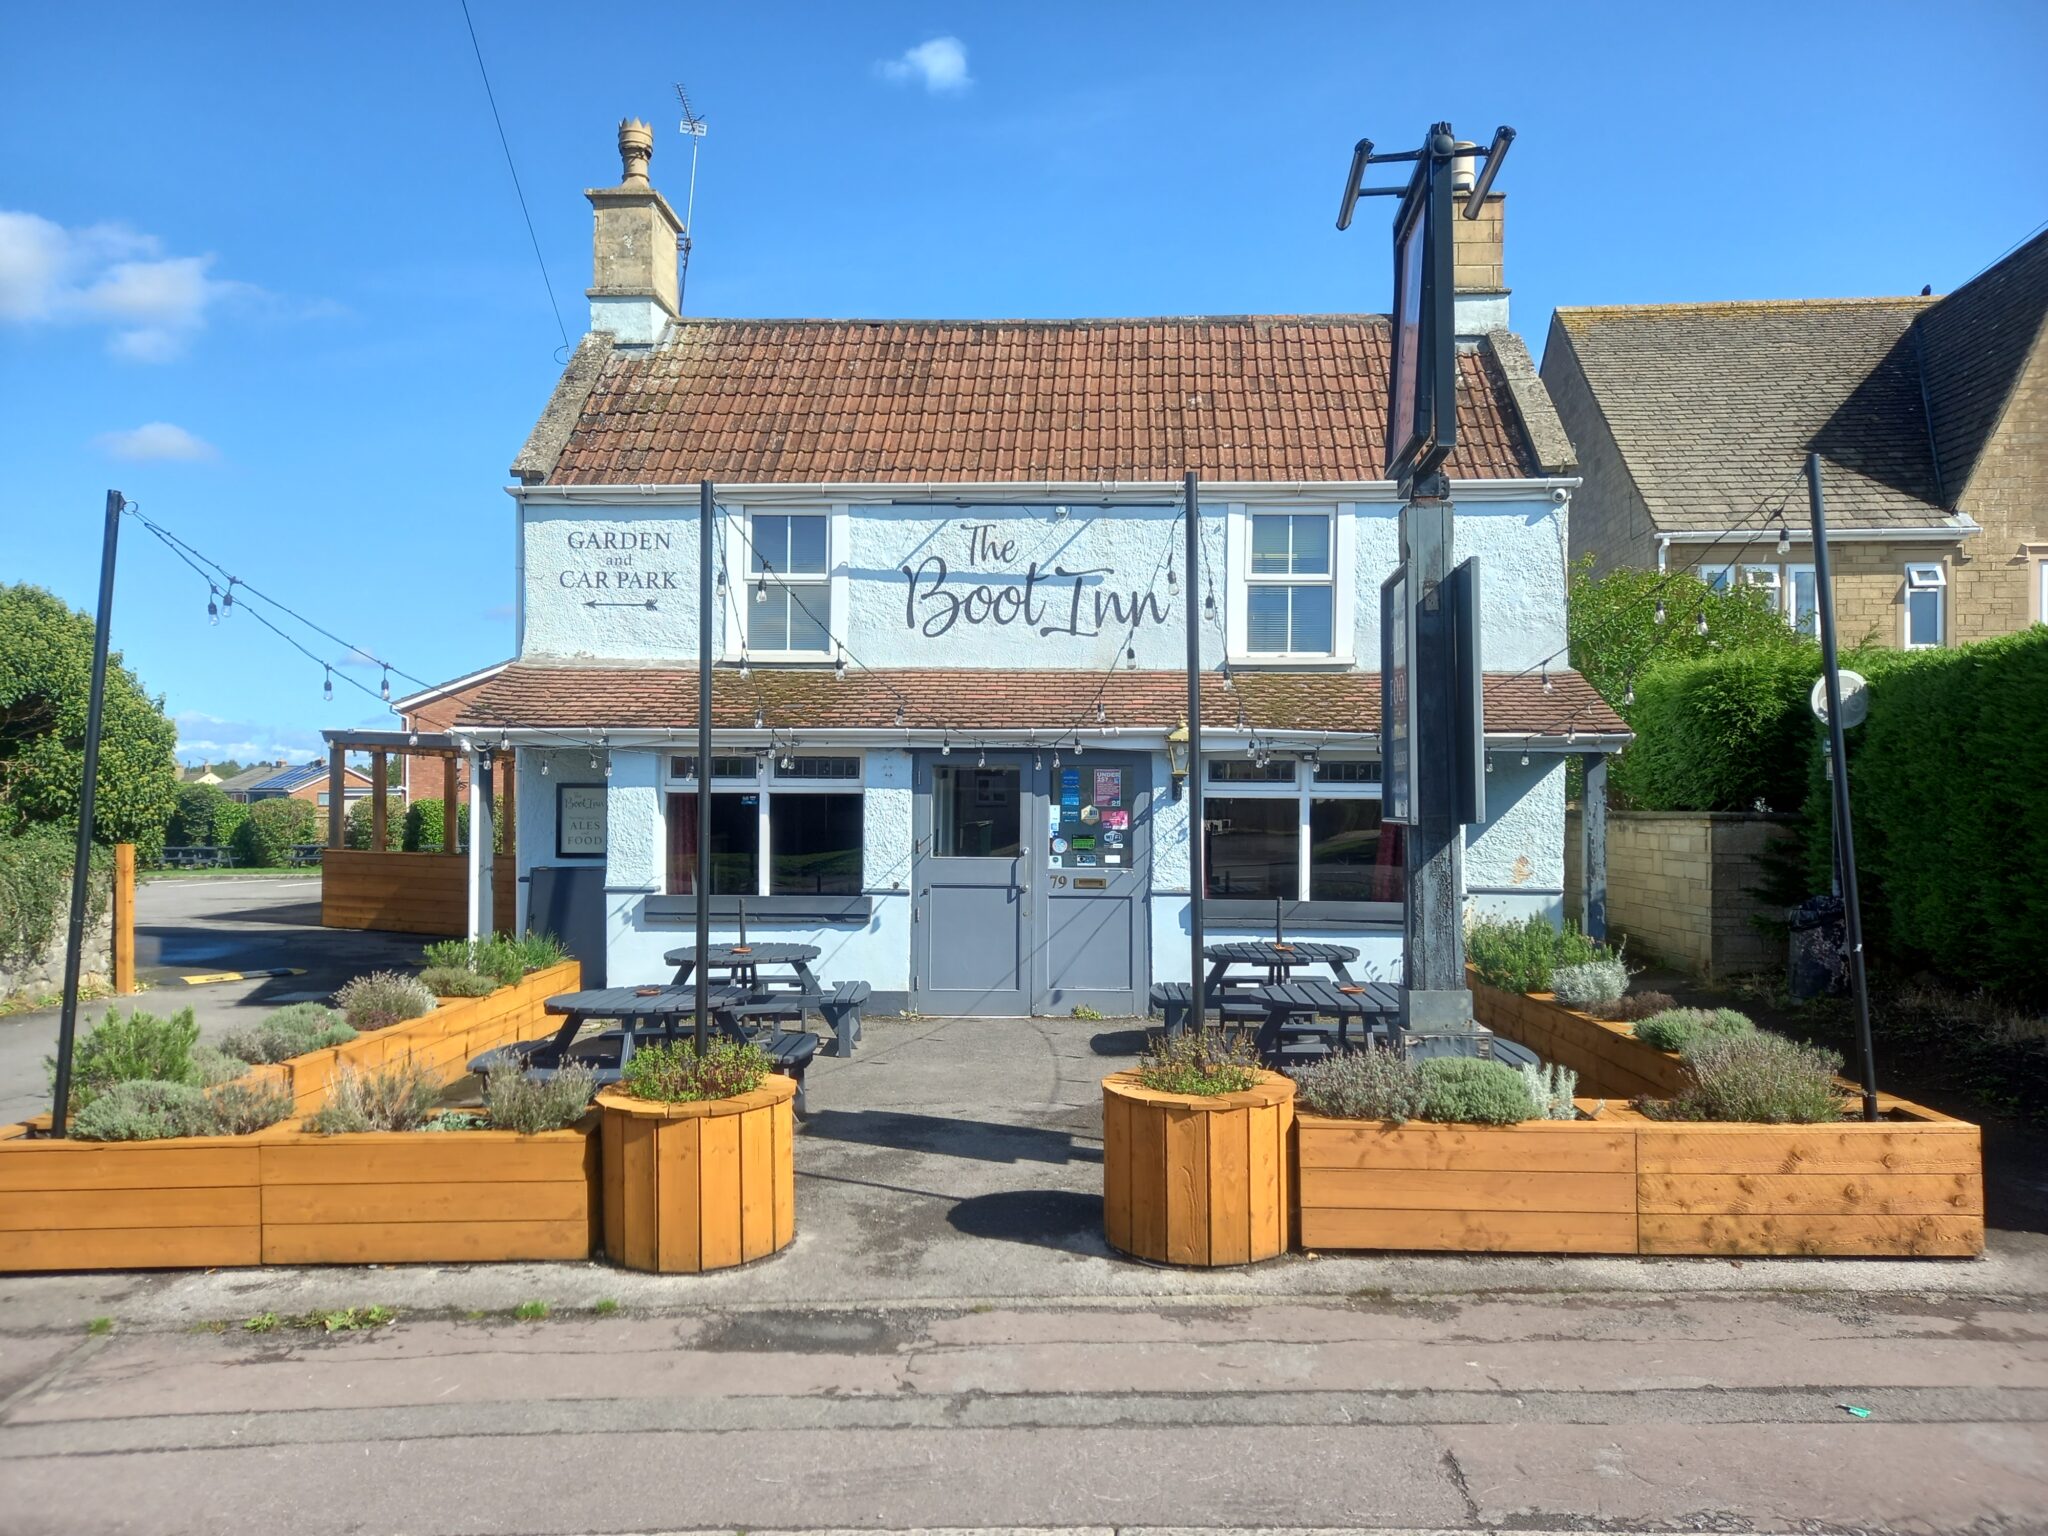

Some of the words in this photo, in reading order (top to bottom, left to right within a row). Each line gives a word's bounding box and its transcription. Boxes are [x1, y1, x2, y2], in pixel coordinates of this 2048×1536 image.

[567, 531, 672, 550] GARDEN
[960, 523, 1019, 566] The
[605, 554, 632, 566] and
[559, 570, 610, 589] CAR
[616, 571, 678, 589] PARK
[902, 556, 1049, 638] Boot
[1040, 566, 1171, 637] Inn
[570, 821, 601, 830] ALES
[567, 837, 603, 845] FOOD
[1050, 875, 1067, 889] 79
